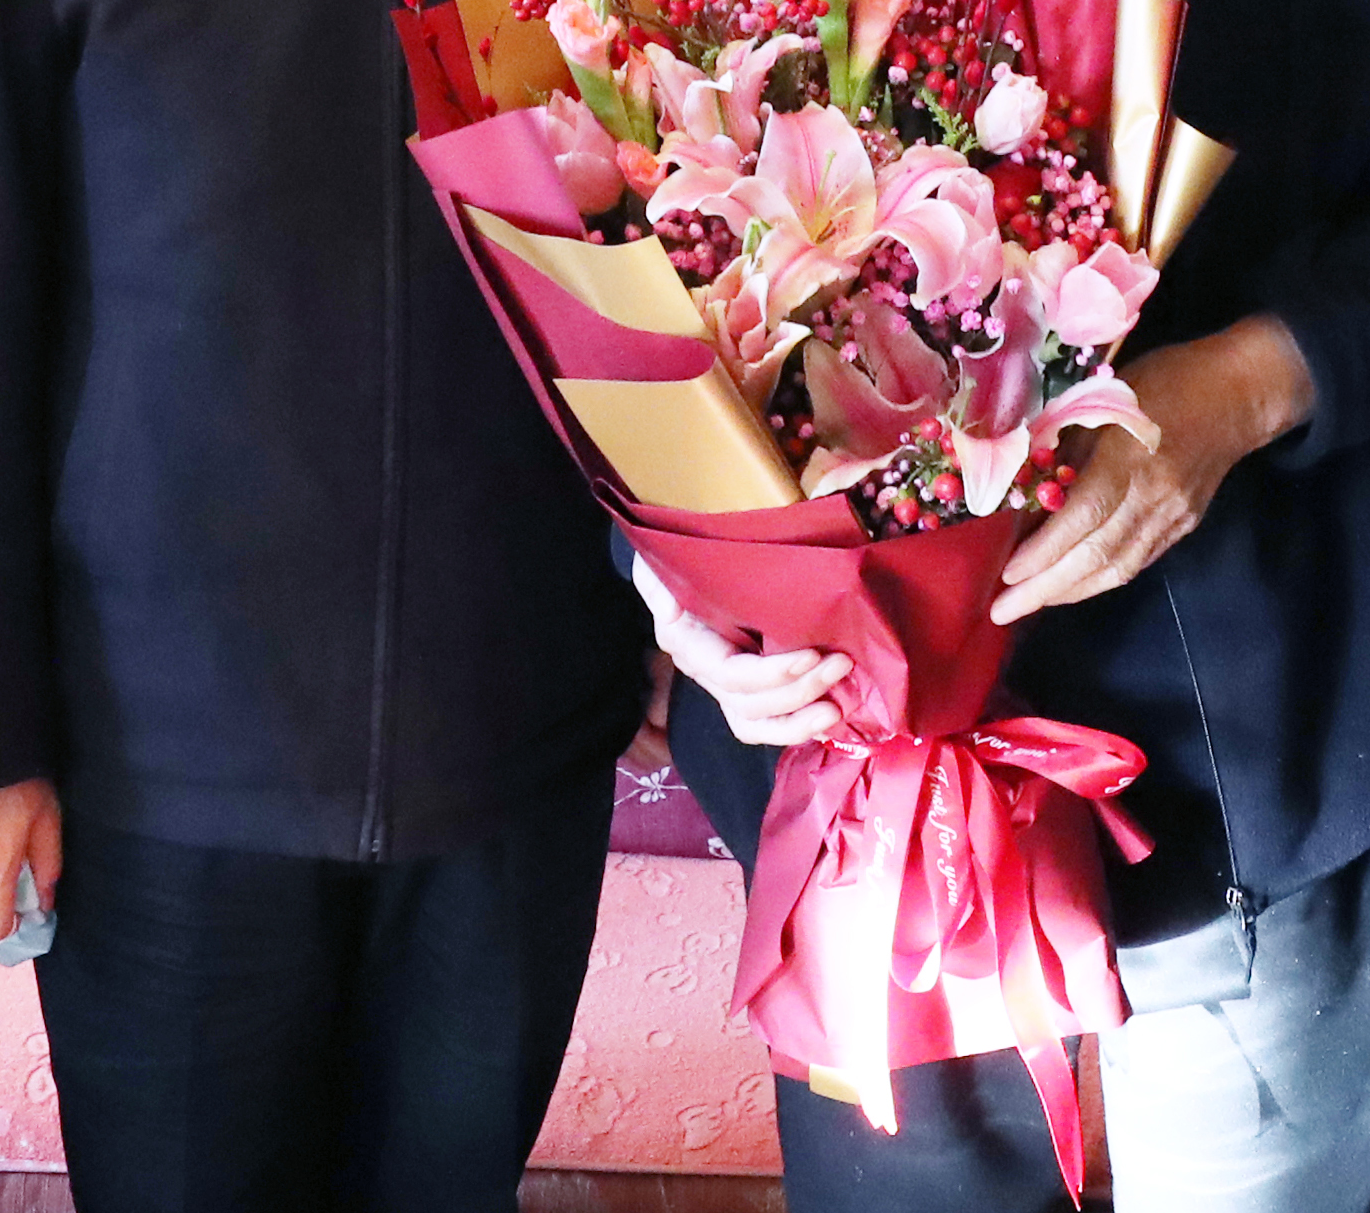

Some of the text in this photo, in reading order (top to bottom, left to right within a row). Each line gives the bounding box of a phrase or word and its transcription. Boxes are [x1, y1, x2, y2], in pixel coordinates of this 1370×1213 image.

[928, 765, 959, 907] Just for you
